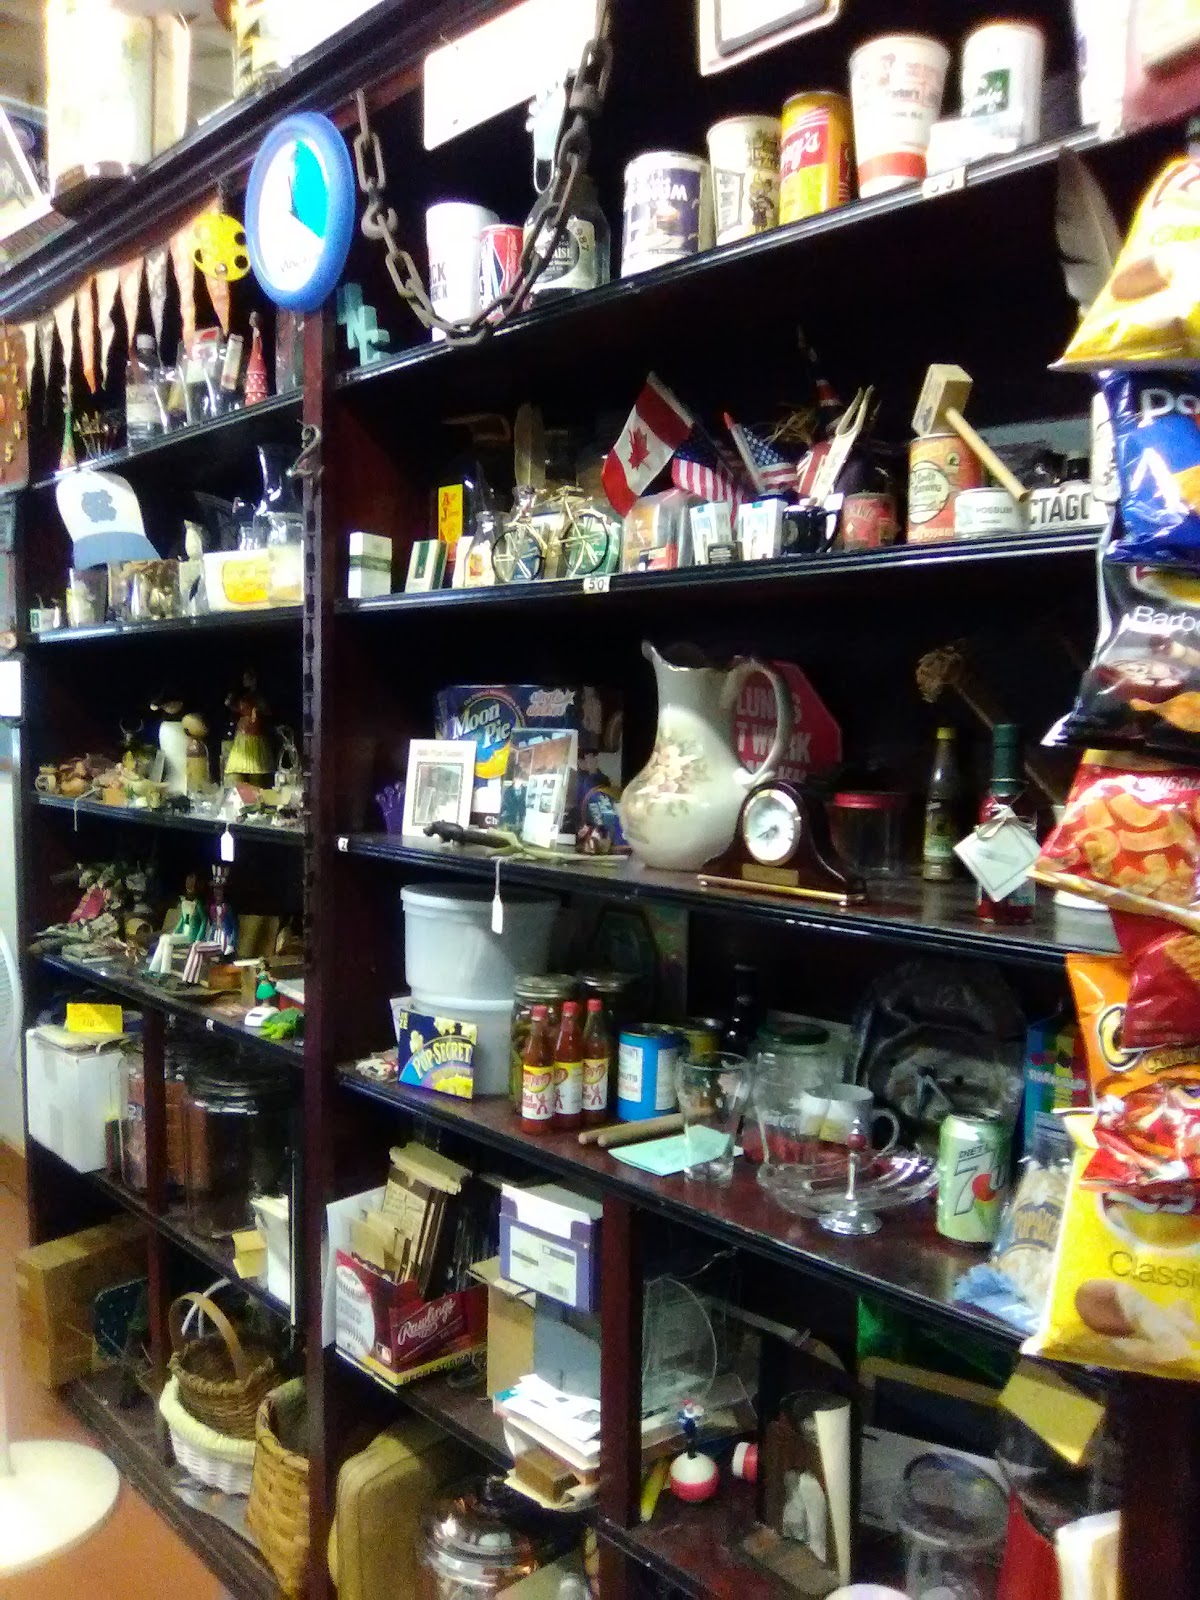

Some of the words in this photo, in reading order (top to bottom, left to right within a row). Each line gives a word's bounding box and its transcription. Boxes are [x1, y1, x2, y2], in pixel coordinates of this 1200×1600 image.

[452, 702, 501, 739] Moon
[483, 720, 513, 750] Pie
[958, 1149, 984, 1160] DIET
[397, 1298, 456, 1346] Rawlings
